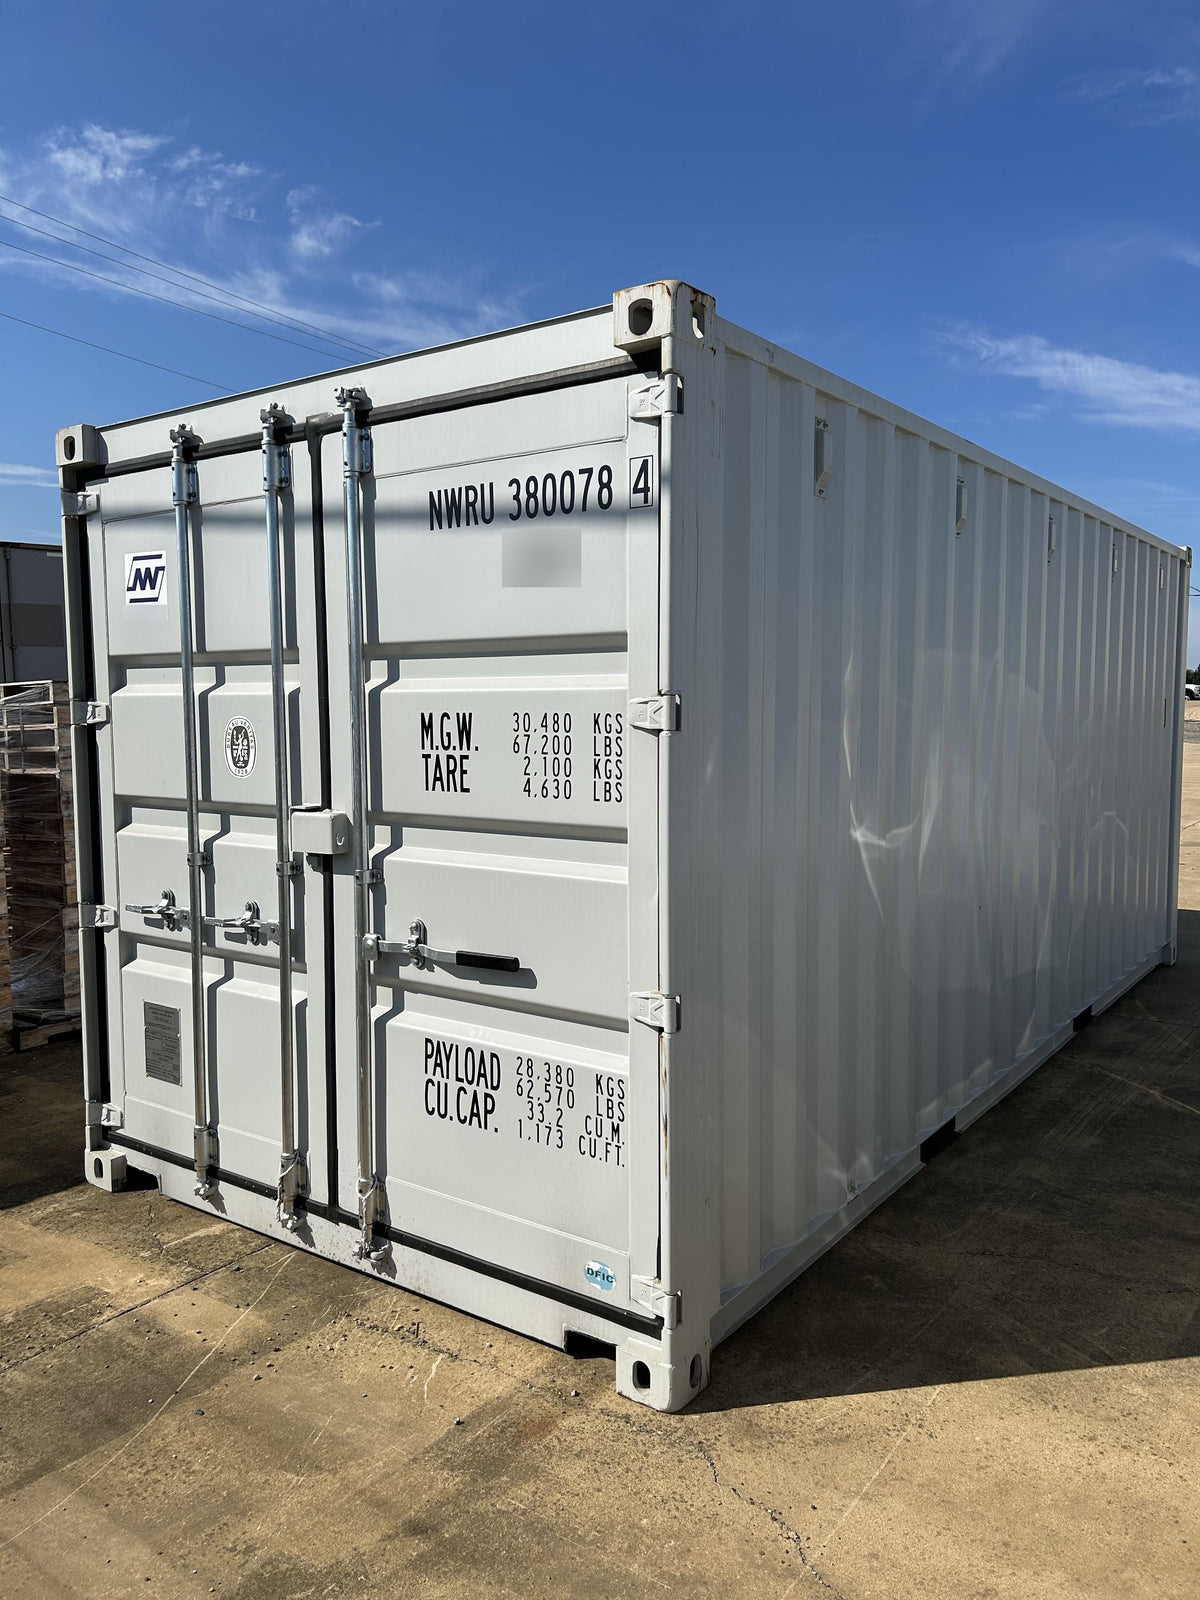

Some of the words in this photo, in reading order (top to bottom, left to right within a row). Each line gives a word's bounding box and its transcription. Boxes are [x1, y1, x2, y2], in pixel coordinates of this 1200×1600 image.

[429, 482, 495, 530] NWRU
[508, 464, 613, 521] 380078
[632, 459, 650, 504] 4
[420, 712, 479, 751] M.G.W.
[513, 712, 572, 733] 30,480
[593, 712, 623, 734] KGS
[512, 734, 572, 755] 67,200
[593, 736, 623, 757] LBS
[421, 753, 471, 793] TARE
[523, 756, 572, 778] 2,100
[593, 758, 623, 780] KGS
[523, 777, 572, 800] 4,630
[593, 780, 623, 802] LBS
[424, 1037, 501, 1091] PAYLOAD
[516, 1056, 574, 1087] 28,380
[595, 1073, 625, 1099] KGS
[424, 1078, 499, 1133] CU.CAP.
[527, 1100, 563, 1128] 33.2
[585, 1115, 625, 1145] CU.M.
[516, 1077, 575, 1109] 62,570
[596, 1095, 625, 1122] LBS
[518, 1119, 564, 1149] 1,173
[578, 1135, 625, 1167] CU.FT.
[586, 1267, 614, 1283] DFIC
